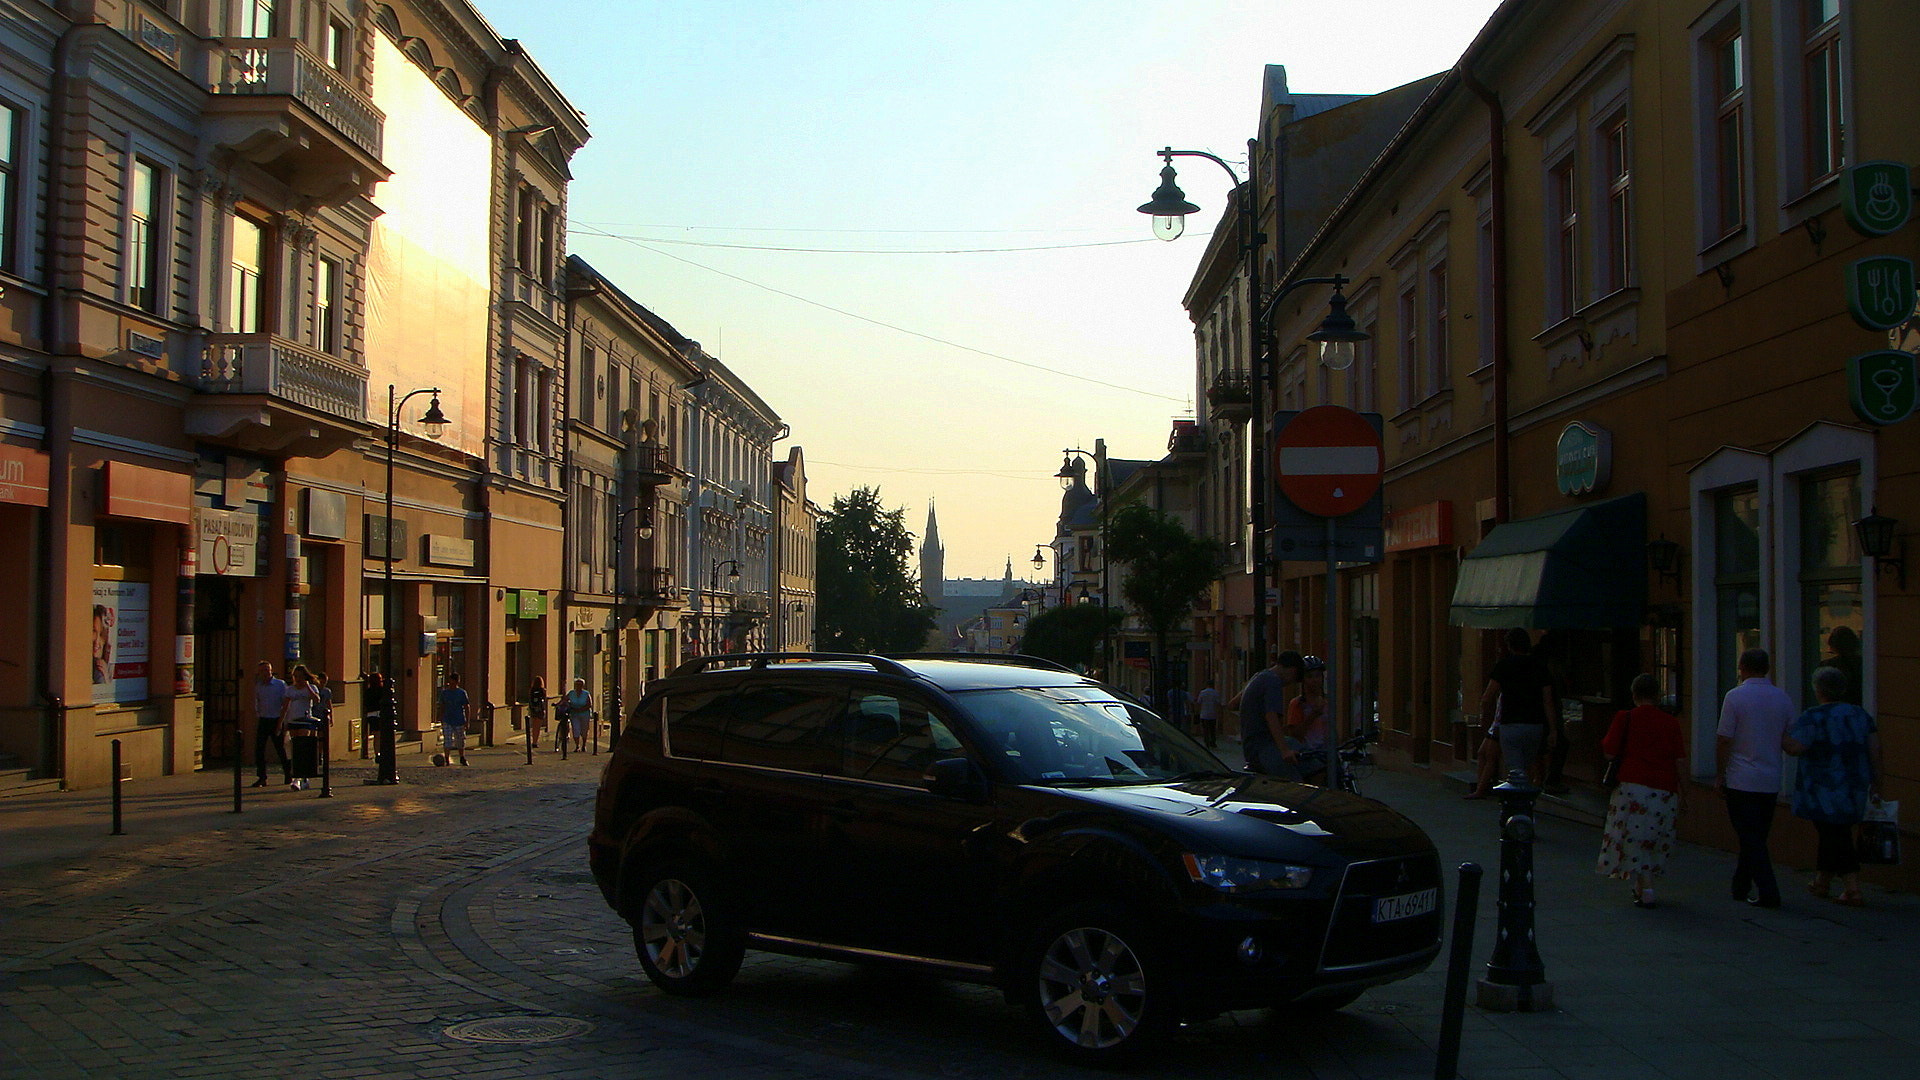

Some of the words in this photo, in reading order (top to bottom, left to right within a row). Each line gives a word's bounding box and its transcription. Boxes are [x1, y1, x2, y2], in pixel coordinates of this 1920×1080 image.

[289, 510, 294, 521] 2
[223, 521, 254, 539] HANDLOWY
[1378, 897, 1401, 921] KTA
[1404, 889, 1435, 916] 69411
